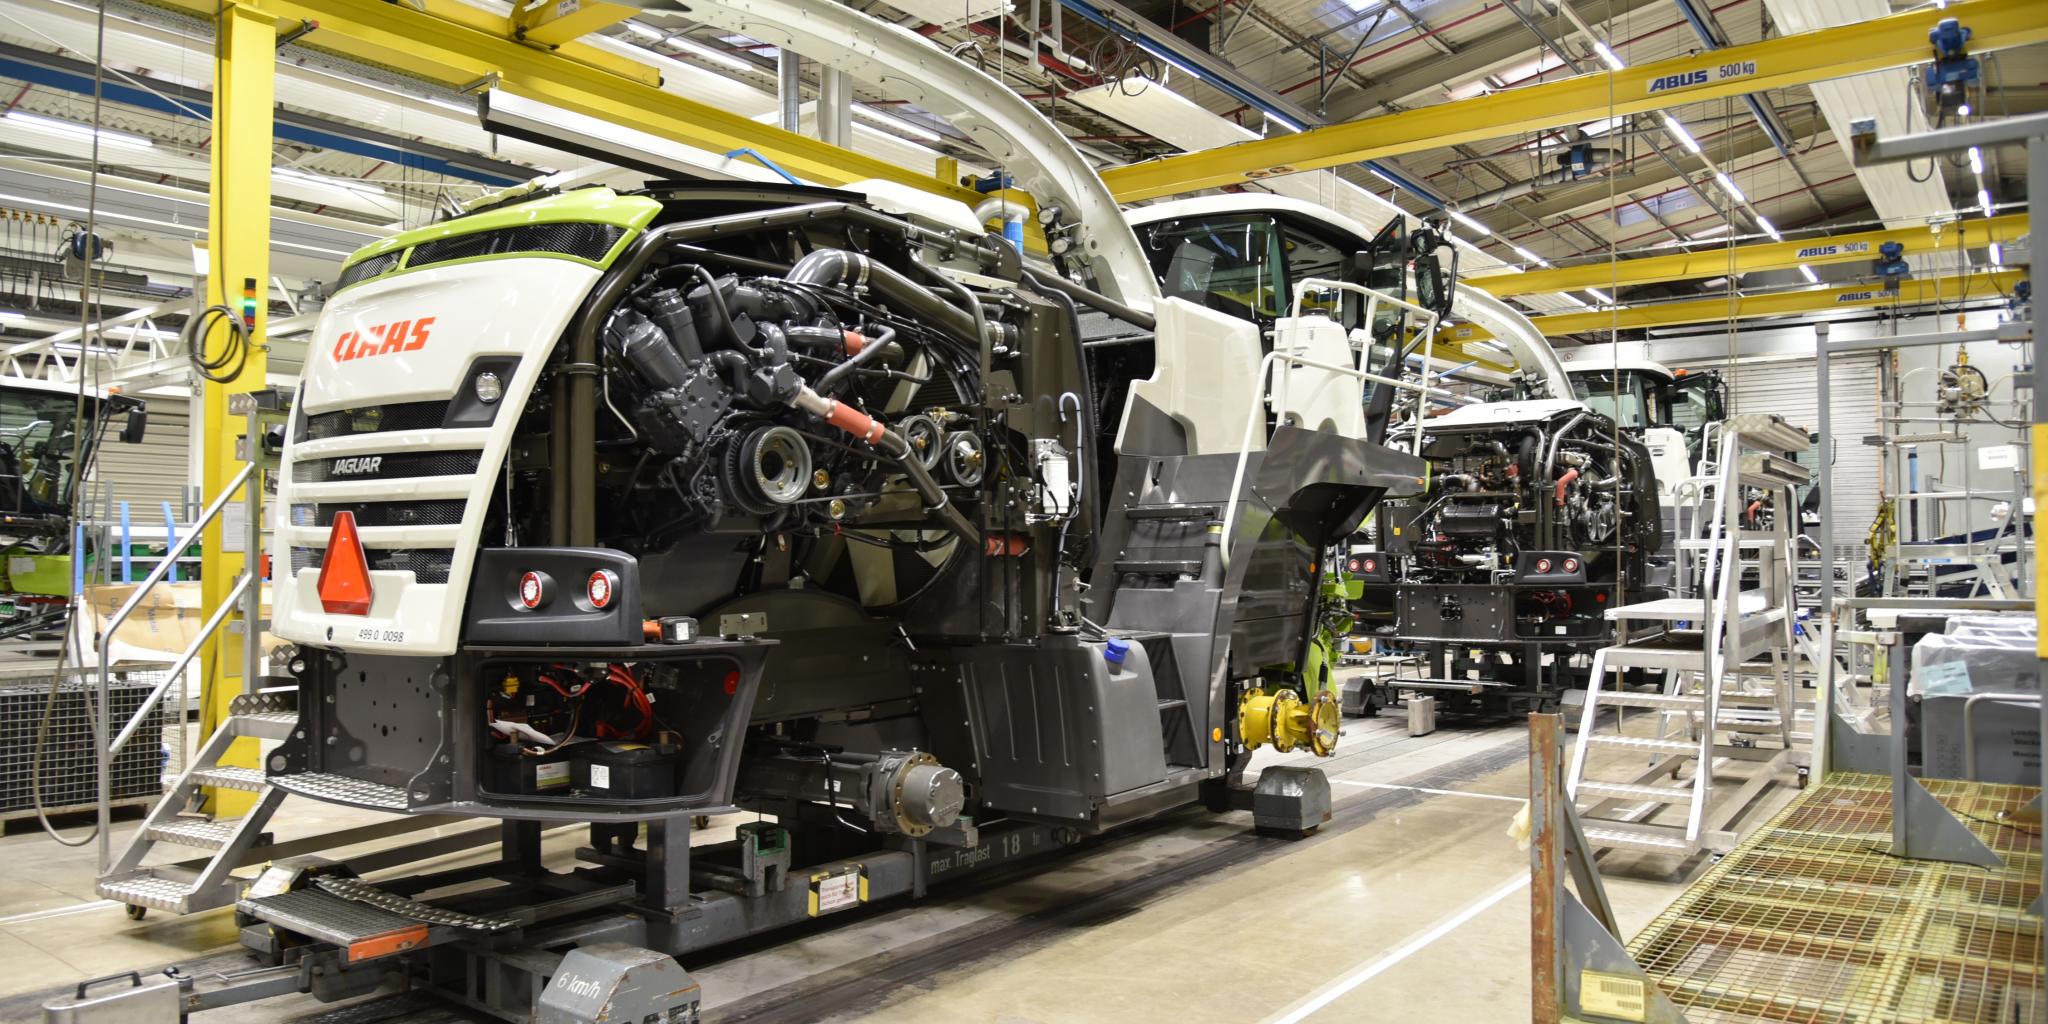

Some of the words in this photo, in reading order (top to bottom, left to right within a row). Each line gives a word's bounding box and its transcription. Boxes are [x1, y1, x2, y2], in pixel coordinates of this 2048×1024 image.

[1649, 70, 1708, 92] ABUS
[1720, 64, 1740, 78] 500
[1743, 62, 1755, 75] kg
[1798, 246, 1837, 258] ABUS
[1838, 292, 1871, 302] ABUS
[332, 317, 437, 363] CLAAS
[332, 457, 382, 475] JAGUAR
[383, 630, 404, 643] 0098
[931, 857, 952, 875] max.
[955, 844, 991, 868] Traglast
[1003, 833, 1021, 858] 18
[557, 972, 570, 989] 6
[567, 975, 601, 1000] km/h
